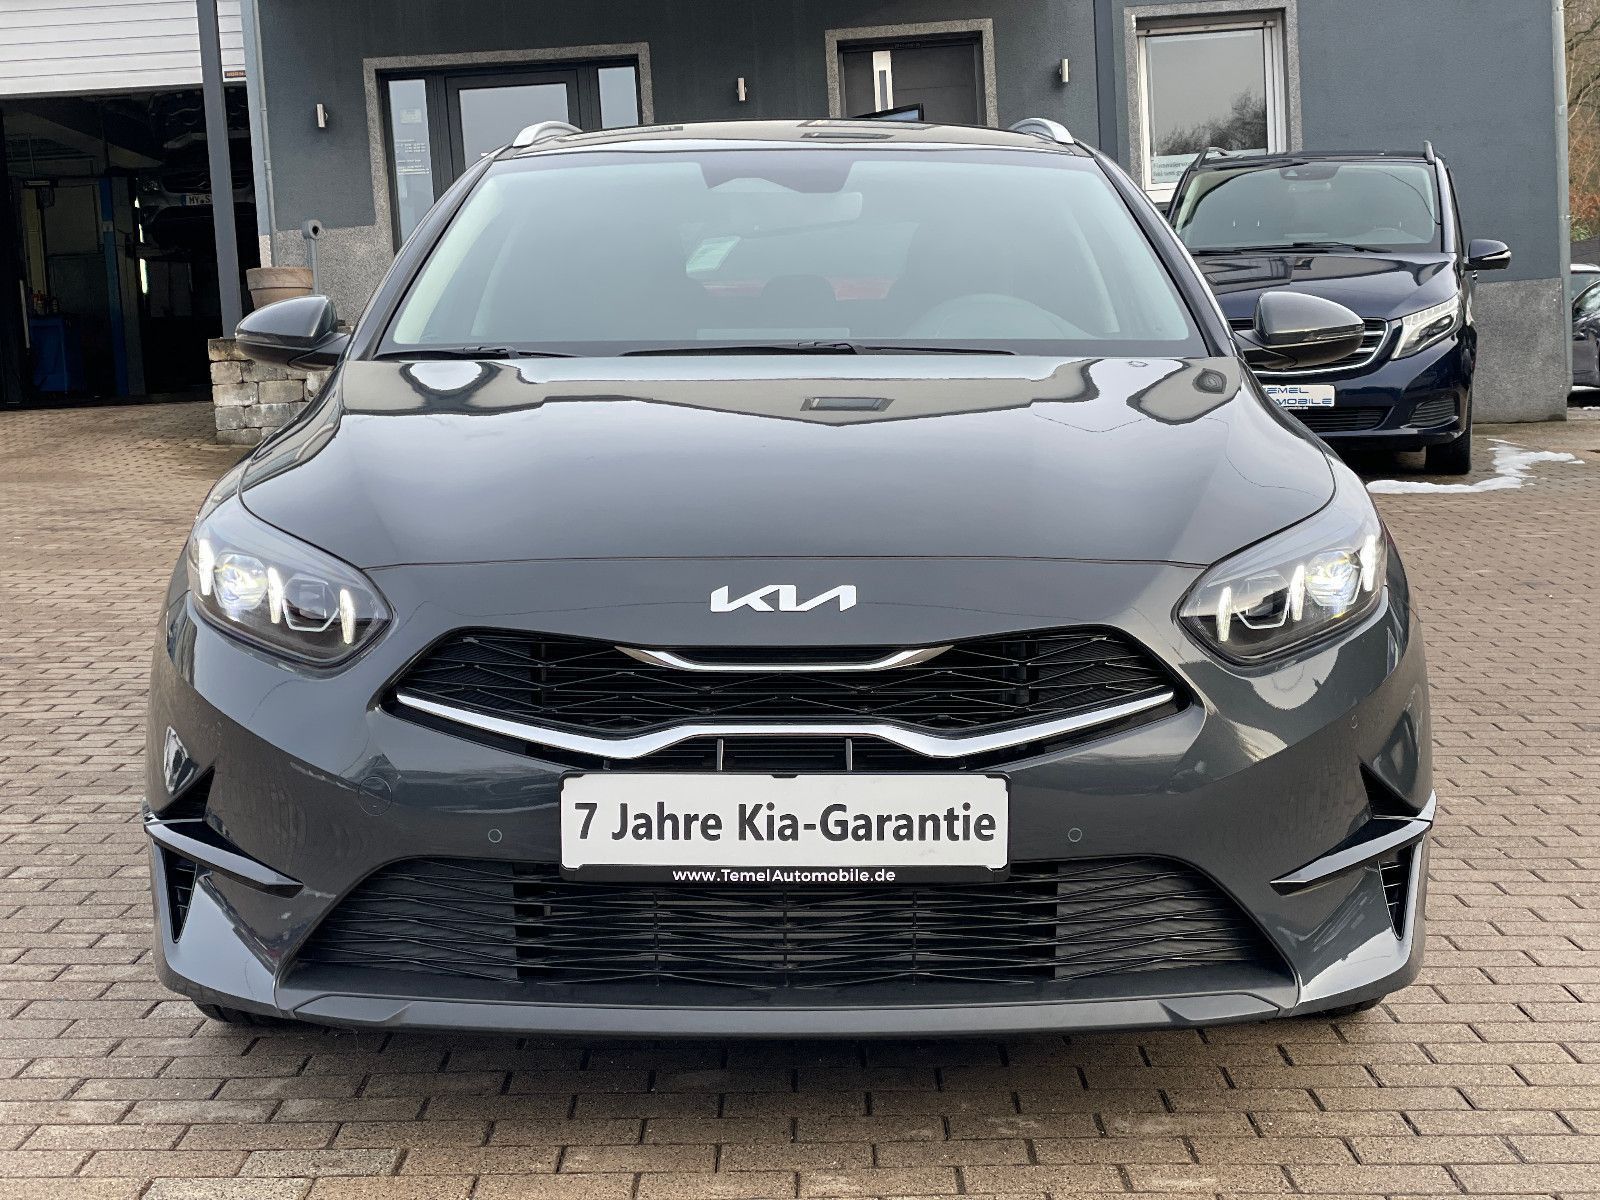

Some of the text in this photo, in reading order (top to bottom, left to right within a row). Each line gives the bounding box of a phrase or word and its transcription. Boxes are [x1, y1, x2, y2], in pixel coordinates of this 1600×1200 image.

[710, 585, 857, 612] KIA
[574, 801, 997, 842] 7 Jahre Kia-Garantie
[672, 867, 896, 883] www.TemelAutomobile.de
